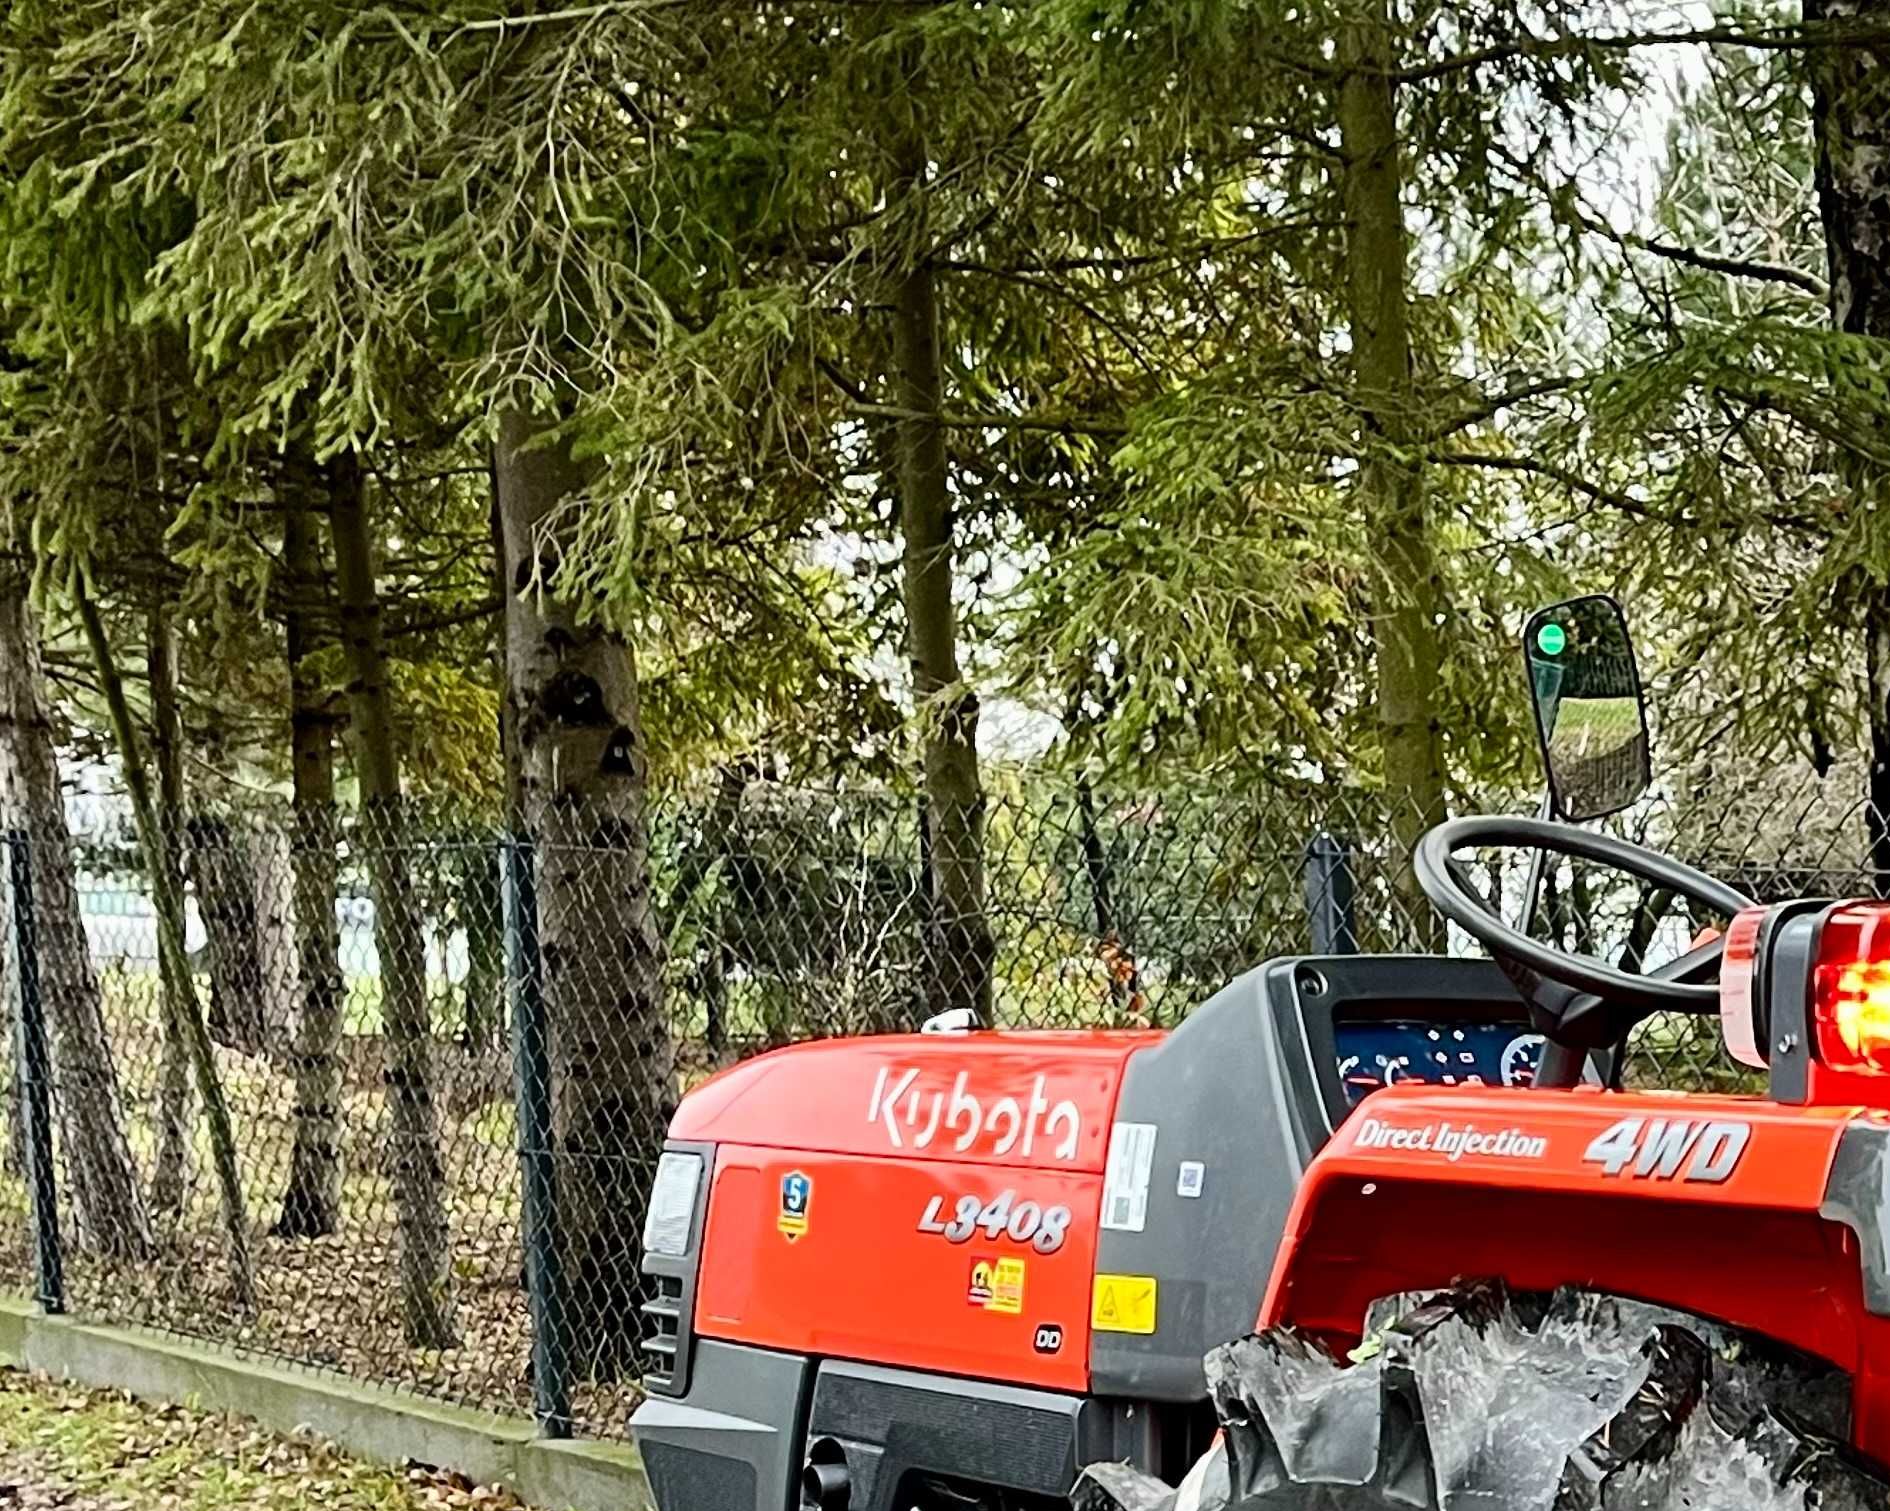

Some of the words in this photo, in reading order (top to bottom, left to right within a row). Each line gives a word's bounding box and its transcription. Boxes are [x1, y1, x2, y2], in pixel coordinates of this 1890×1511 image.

[868, 1067, 1080, 1160] Kubota
[1354, 1118, 1432, 1150] Direct
[1431, 1122, 1547, 1162] Injection
[1582, 1116, 1752, 1184] 4WD
[916, 1189, 1072, 1254] L3408
